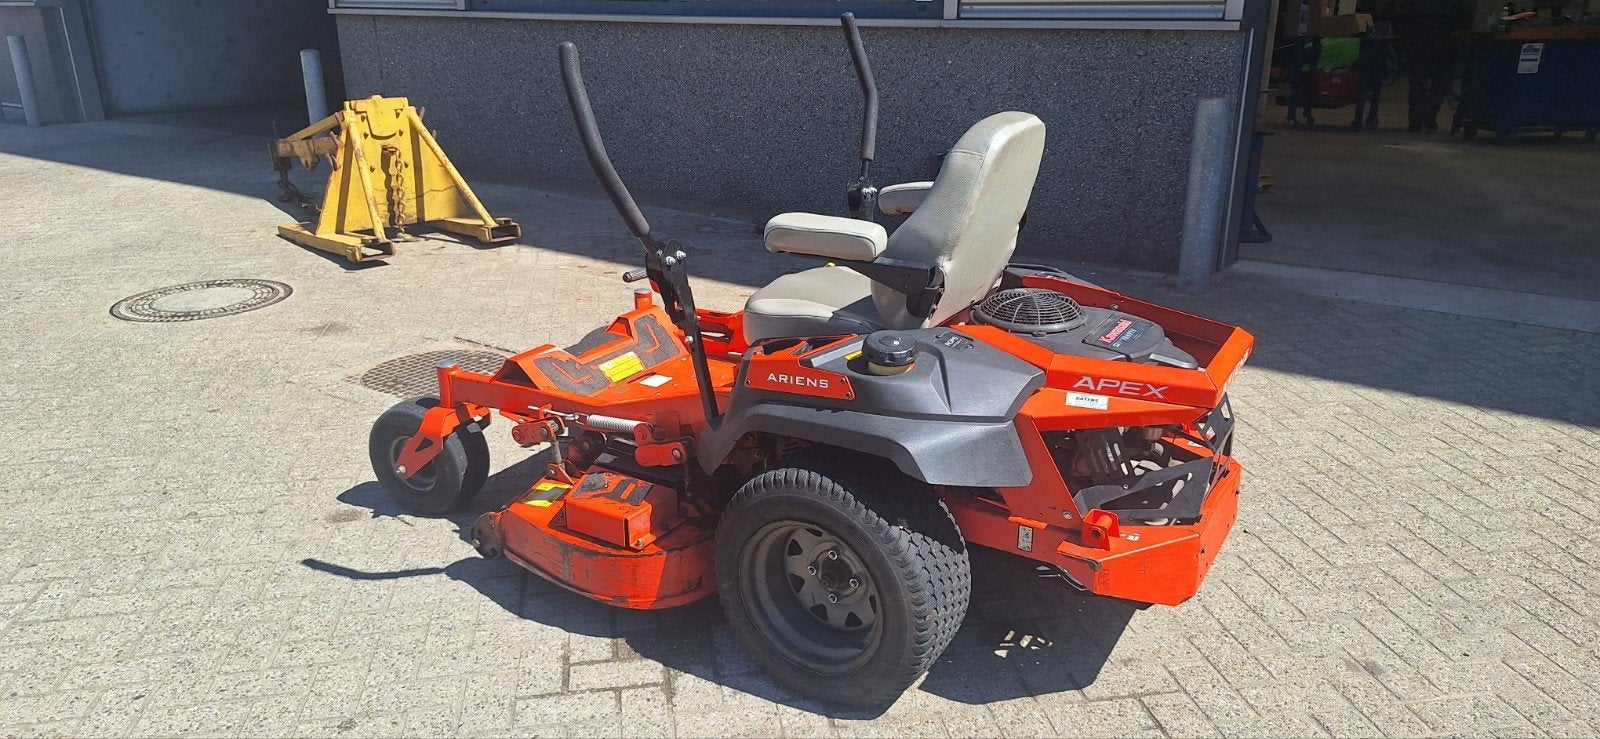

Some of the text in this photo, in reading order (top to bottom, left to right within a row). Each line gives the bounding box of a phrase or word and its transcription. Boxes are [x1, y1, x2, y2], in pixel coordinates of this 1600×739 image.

[1098, 318, 1132, 343] Kawasaki
[767, 372, 829, 389] ARIENS
[1072, 375, 1169, 399] APEX
